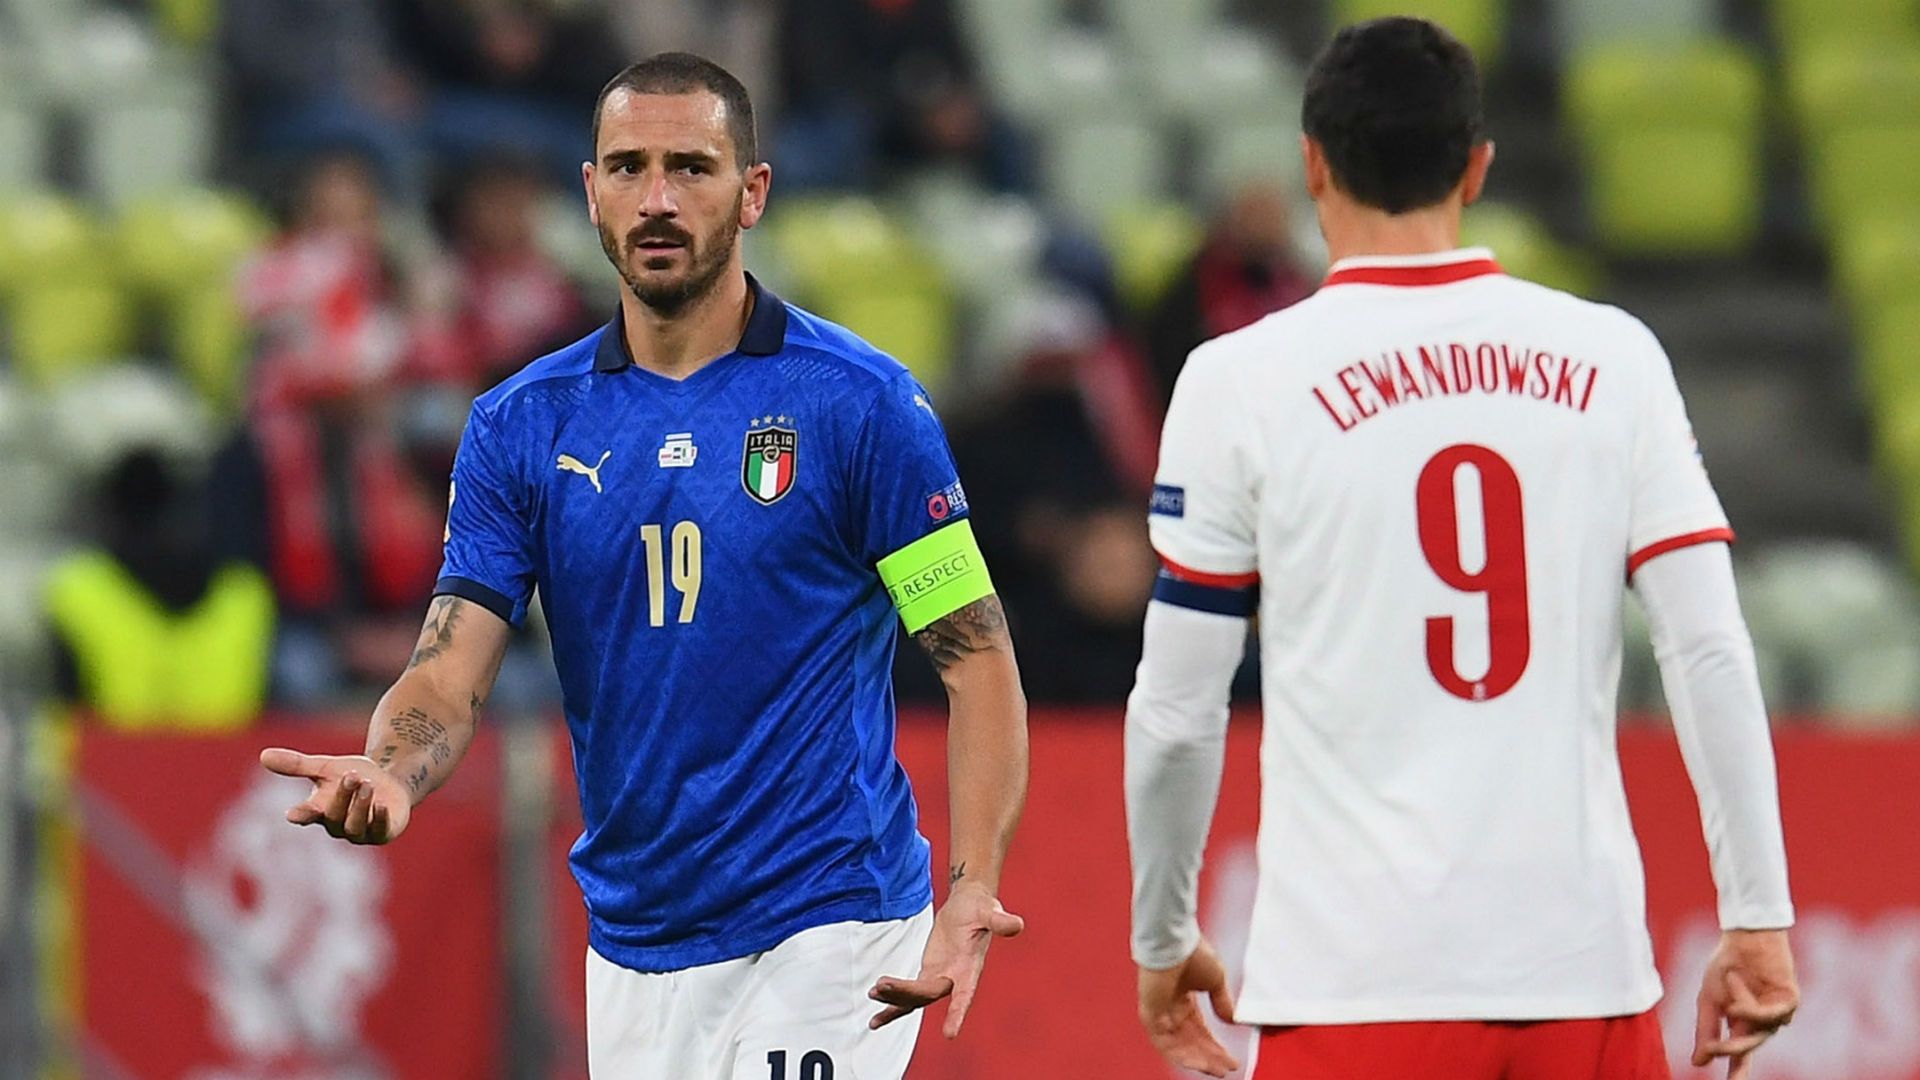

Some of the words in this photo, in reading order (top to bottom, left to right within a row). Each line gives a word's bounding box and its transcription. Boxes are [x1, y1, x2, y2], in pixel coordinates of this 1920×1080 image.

[1313, 343, 1598, 432] LEWANDOWSKI
[750, 434, 793, 447] ITALIA
[640, 520, 702, 628] 19
[903, 554, 970, 598] RESPECT
[1415, 442, 1532, 702] 9
